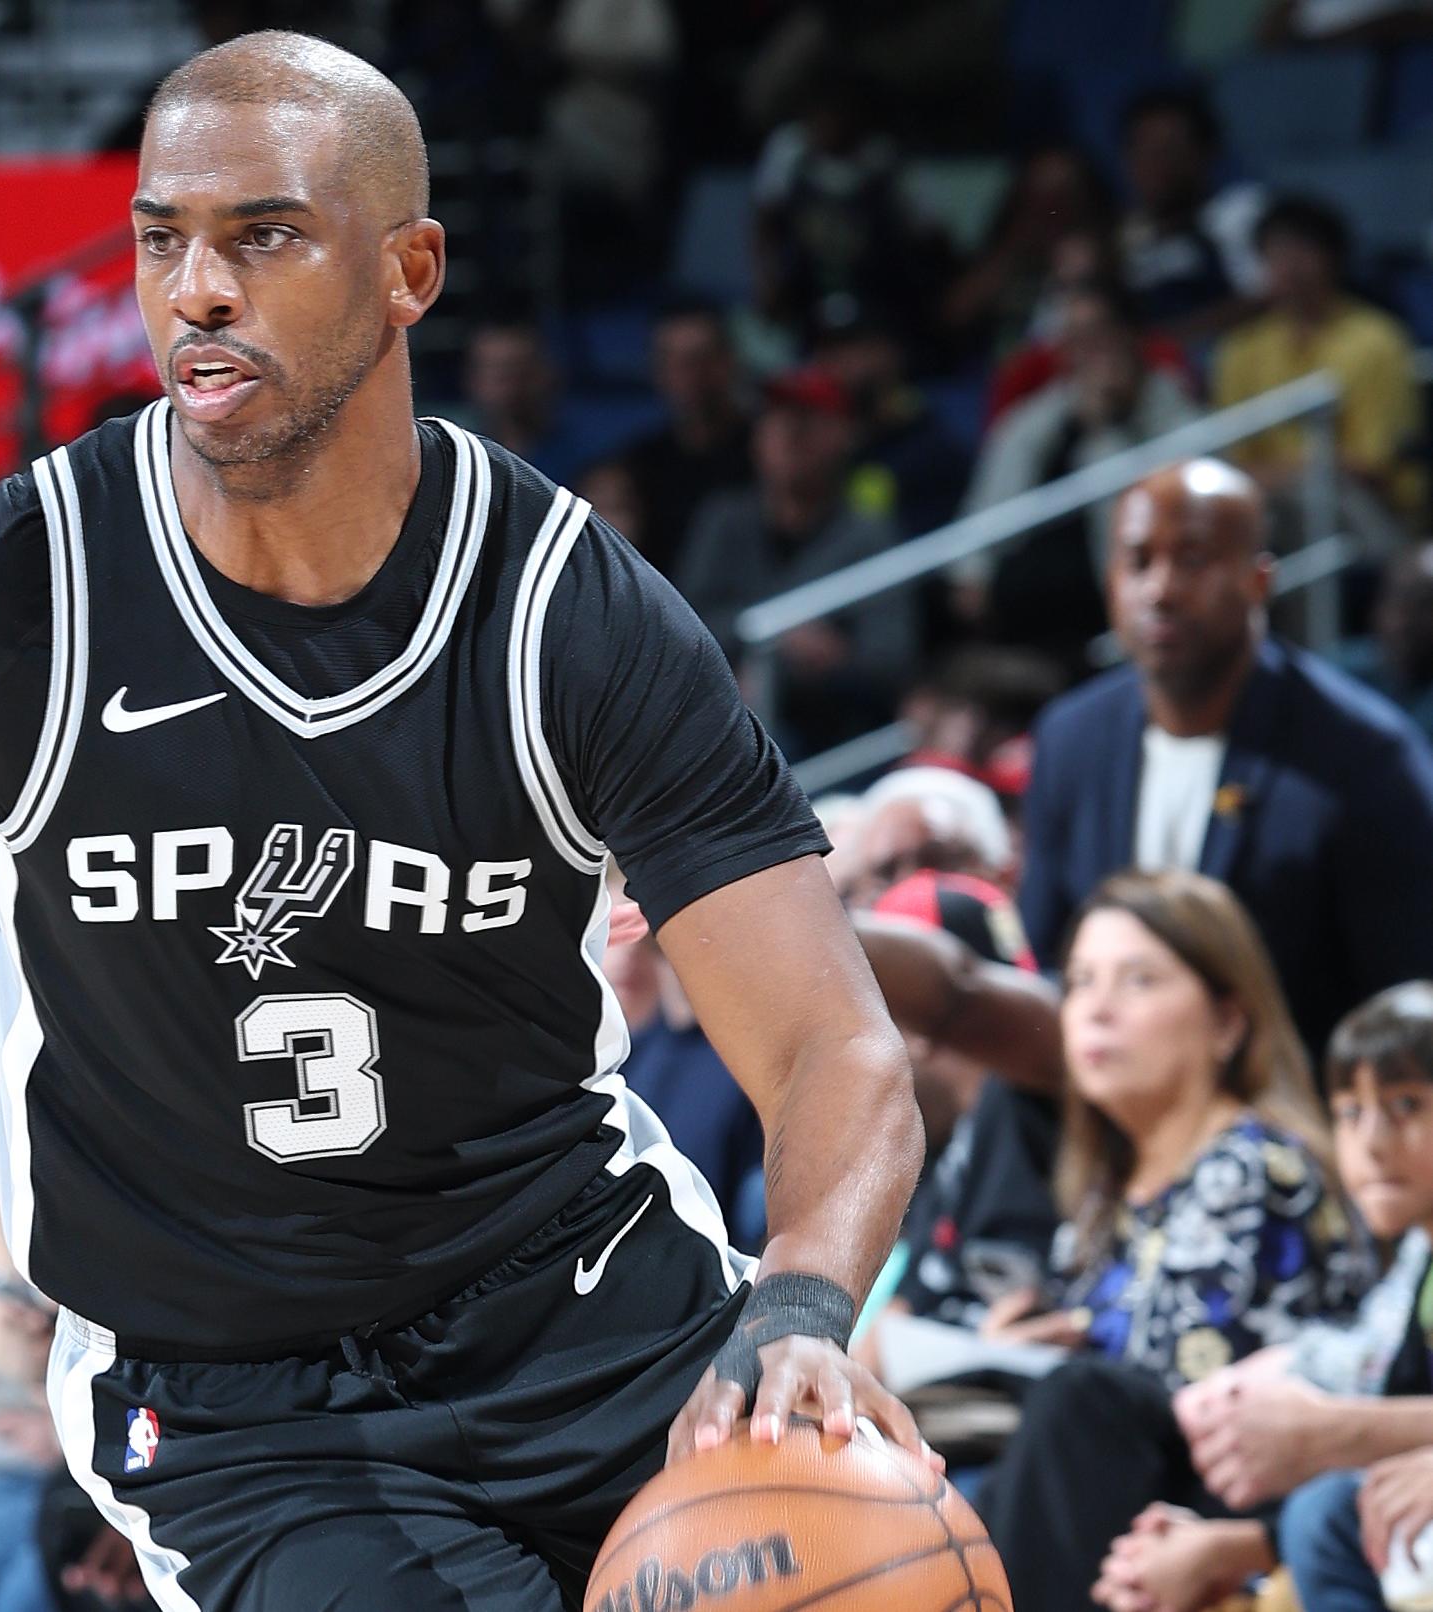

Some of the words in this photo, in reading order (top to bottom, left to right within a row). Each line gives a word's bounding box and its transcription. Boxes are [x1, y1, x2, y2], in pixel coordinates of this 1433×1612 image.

[66, 823, 533, 980] SPURS
[234, 993, 387, 1163] 3
[594, 1532, 799, 1612] ilson
